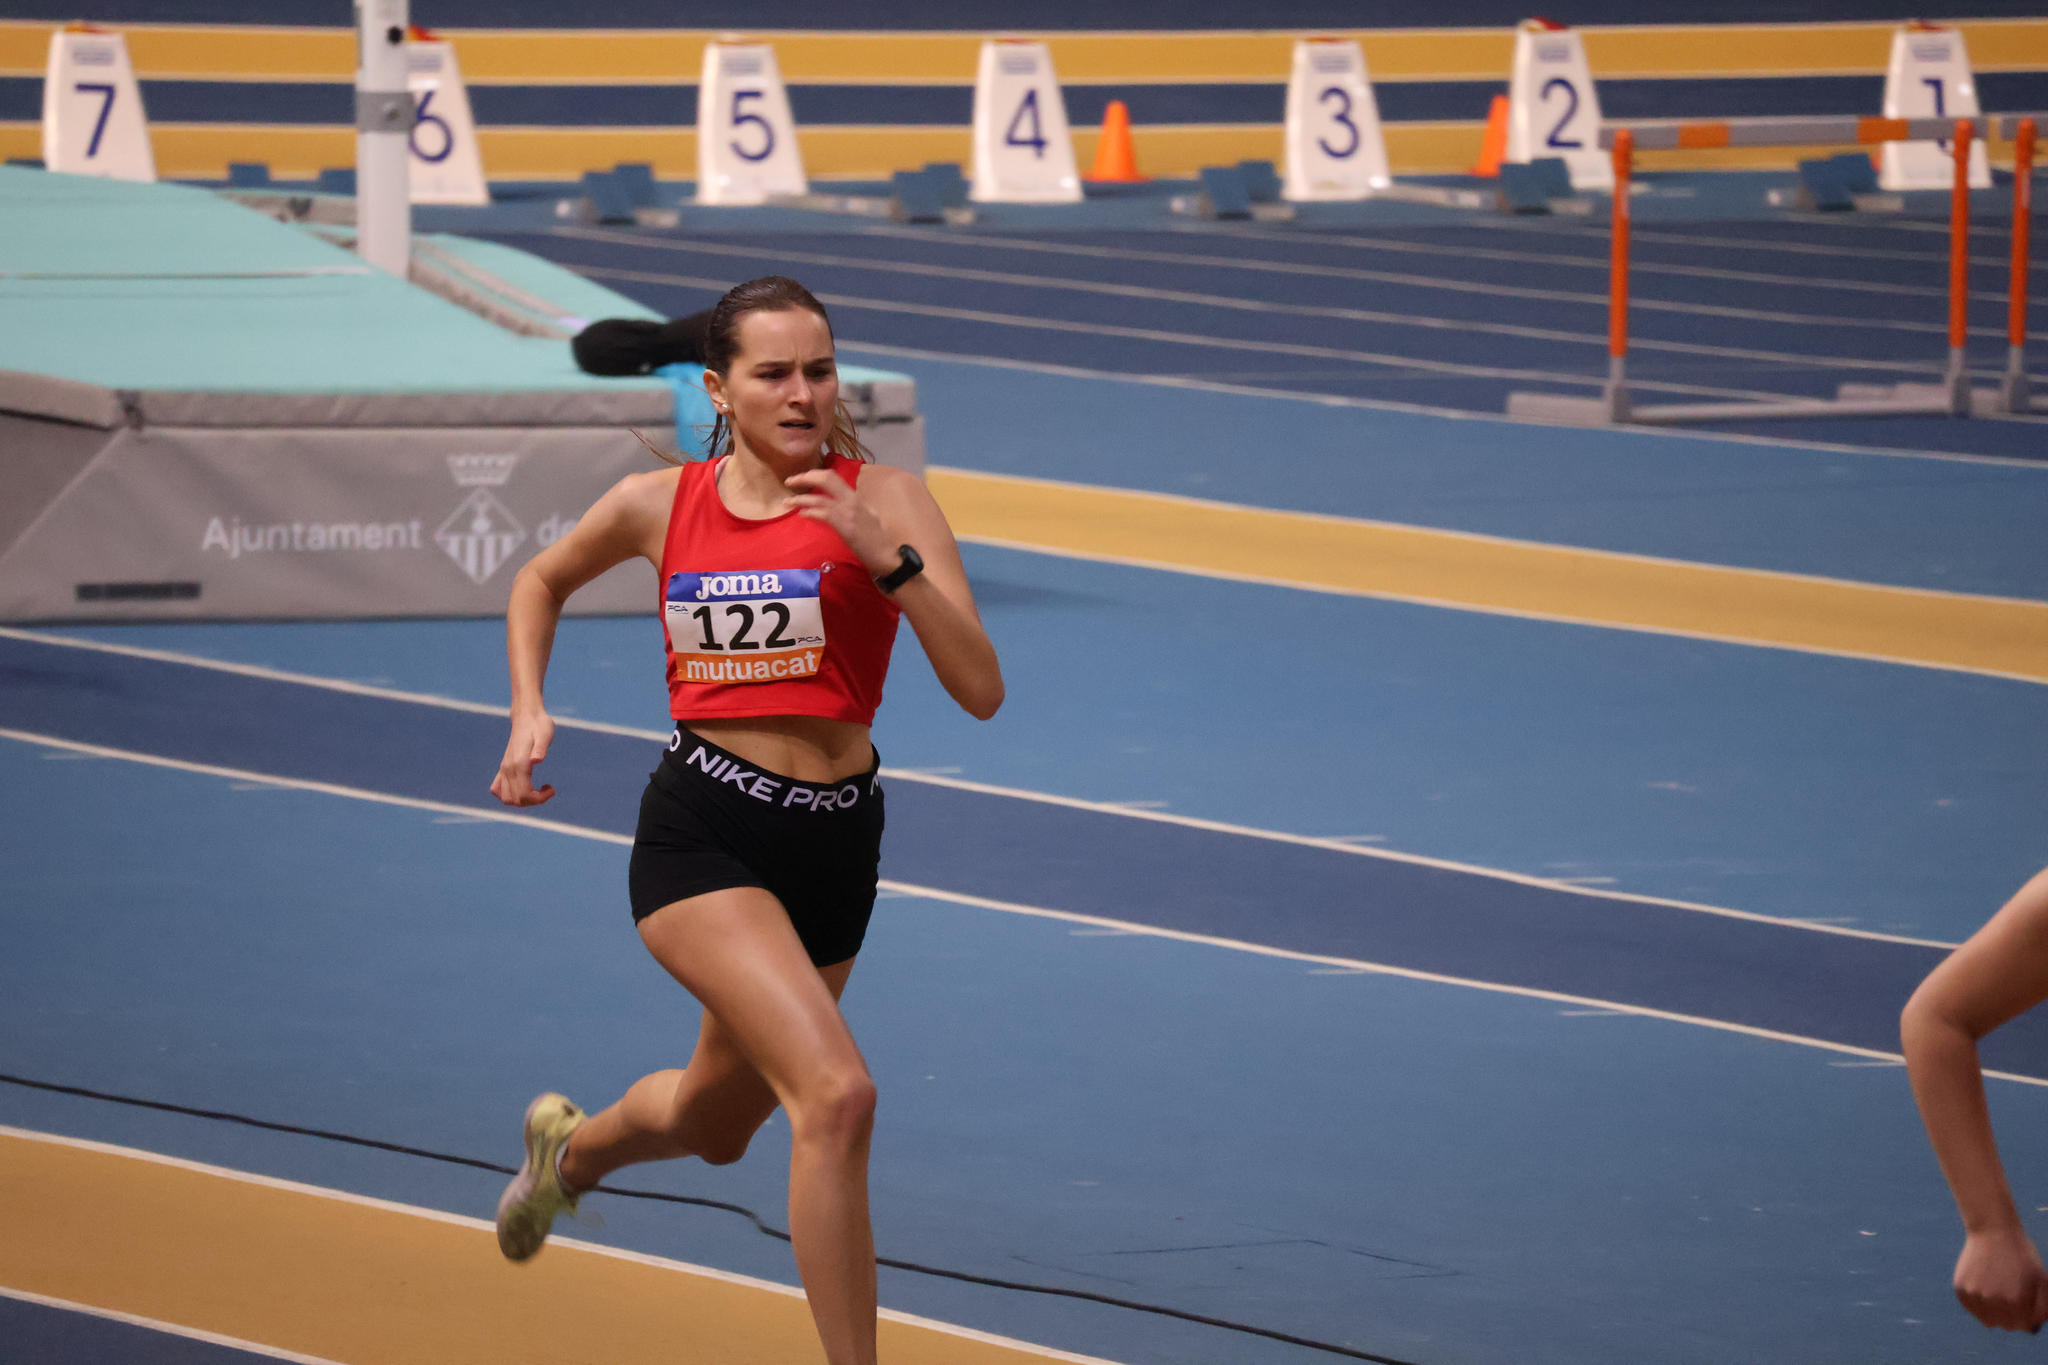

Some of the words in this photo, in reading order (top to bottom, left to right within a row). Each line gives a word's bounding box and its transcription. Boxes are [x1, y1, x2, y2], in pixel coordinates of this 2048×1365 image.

[74, 83, 117, 158] 7
[409, 90, 454, 163] 6
[730, 91, 775, 163] 5
[1004, 90, 1049, 158] 4
[1318, 87, 1361, 159] 3
[1540, 78, 1582, 148] 2
[1920, 76, 1947, 149] 1
[201, 515, 422, 560] Ajuntament
[693, 602, 796, 651] 122
[687, 650, 818, 681] mutuacat
[685, 745, 782, 803] NIKE
[782, 784, 859, 812] PRO
